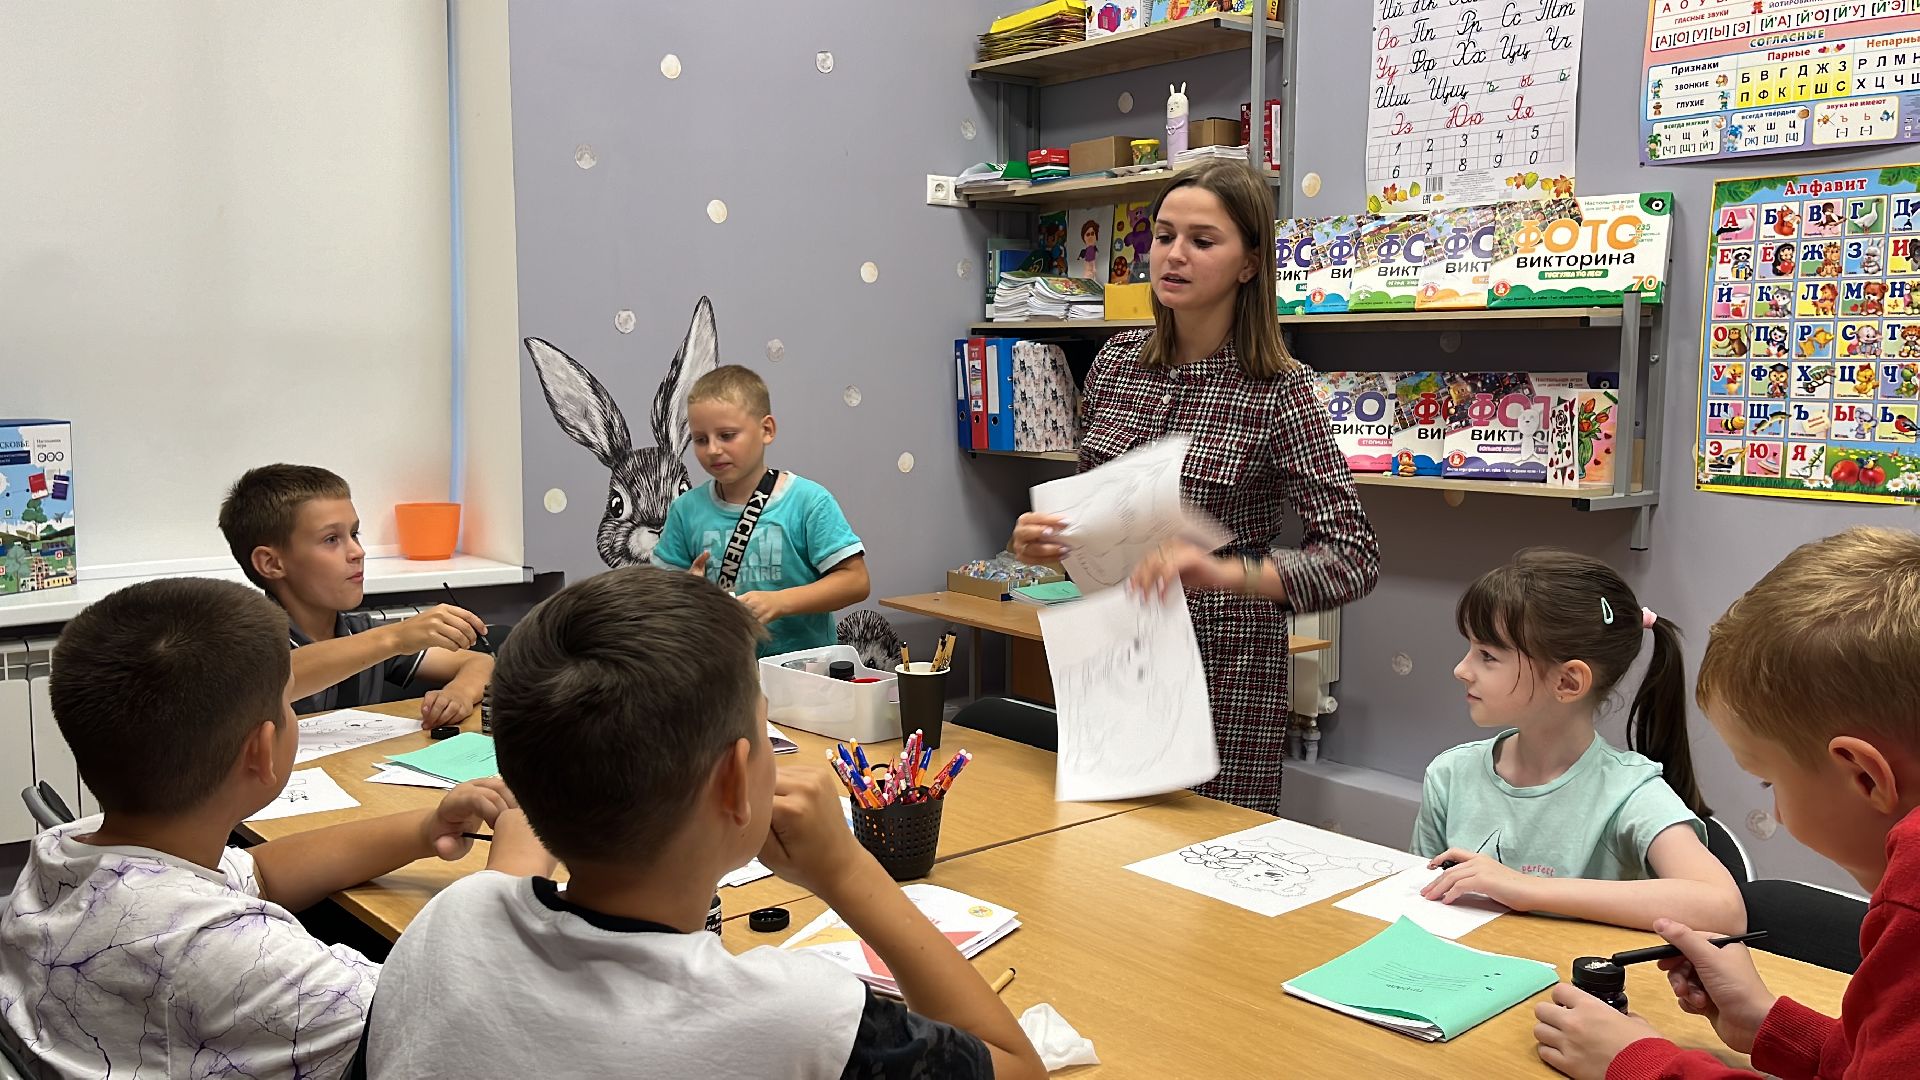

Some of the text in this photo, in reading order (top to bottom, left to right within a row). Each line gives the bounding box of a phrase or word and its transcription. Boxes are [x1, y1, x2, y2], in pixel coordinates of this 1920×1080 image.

[1663, 3, 1671, 13] А
[1680, 0, 1689, 9] О
[1674, 9, 1729, 25] ГЛАСНЫЕ ЗВУКИ
[1378, 0, 1576, 50] Оо Пп Рр Сс Тт
[1750, 29, 1825, 48] СОГЛАСНЫЕ
[1377, 27, 1572, 85] Уу Фф Хх Цц Чч
[1671, 62, 1719, 75] Признаки
[1768, 49, 1811, 61] Парные
[1741, 72, 1750, 83] Б
[1761, 70, 1769, 81] В
[1779, 67, 1787, 78] Г
[1798, 64, 1808, 78] Д
[1816, 62, 1830, 74] Ж
[1838, 61, 1847, 72] З
[1858, 58, 1867, 69] Р
[1876, 55, 1887, 67] Л
[1894, 53, 1906, 65] М
[1376, 86, 1410, 108] Шш
[1429, 77, 1469, 104] Щщ
[1674, 80, 1709, 91] ЗВОНКИЕ
[1740, 74, 1904, 102] П Ф К Т Ш С Х Ц Ч
[1676, 99, 1705, 108] ГЛУХИЕ
[1391, 95, 1534, 136] Ээ Юю Яя
[1394, 125, 1540, 155] 1 2 3 4 5
[1392, 150, 1538, 179] 6 7 8 9 0
[1784, 178, 1868, 197] Алфавит
[1723, 199, 1911, 228] А Б В Г Д
[1329, 235, 1364, 266] Ф
[1516, 252, 1635, 270] викторина
[1719, 239, 1910, 264] Е Ё Ж З И
[1632, 275, 1657, 291] 70
[1717, 281, 1906, 303] Й К Л М Н
[1713, 323, 1901, 342] О П Р С Т
[1713, 365, 1899, 385] У Ф Х Ц Ч
[1414, 392, 1450, 425] Ф
[1749, 403, 1770, 421] Щ
[1793, 404, 1809, 421] Ъ
[1834, 405, 1856, 421] Ы
[1880, 406, 1895, 423] Ь
[1709, 440, 1807, 461] Э Ю Я
